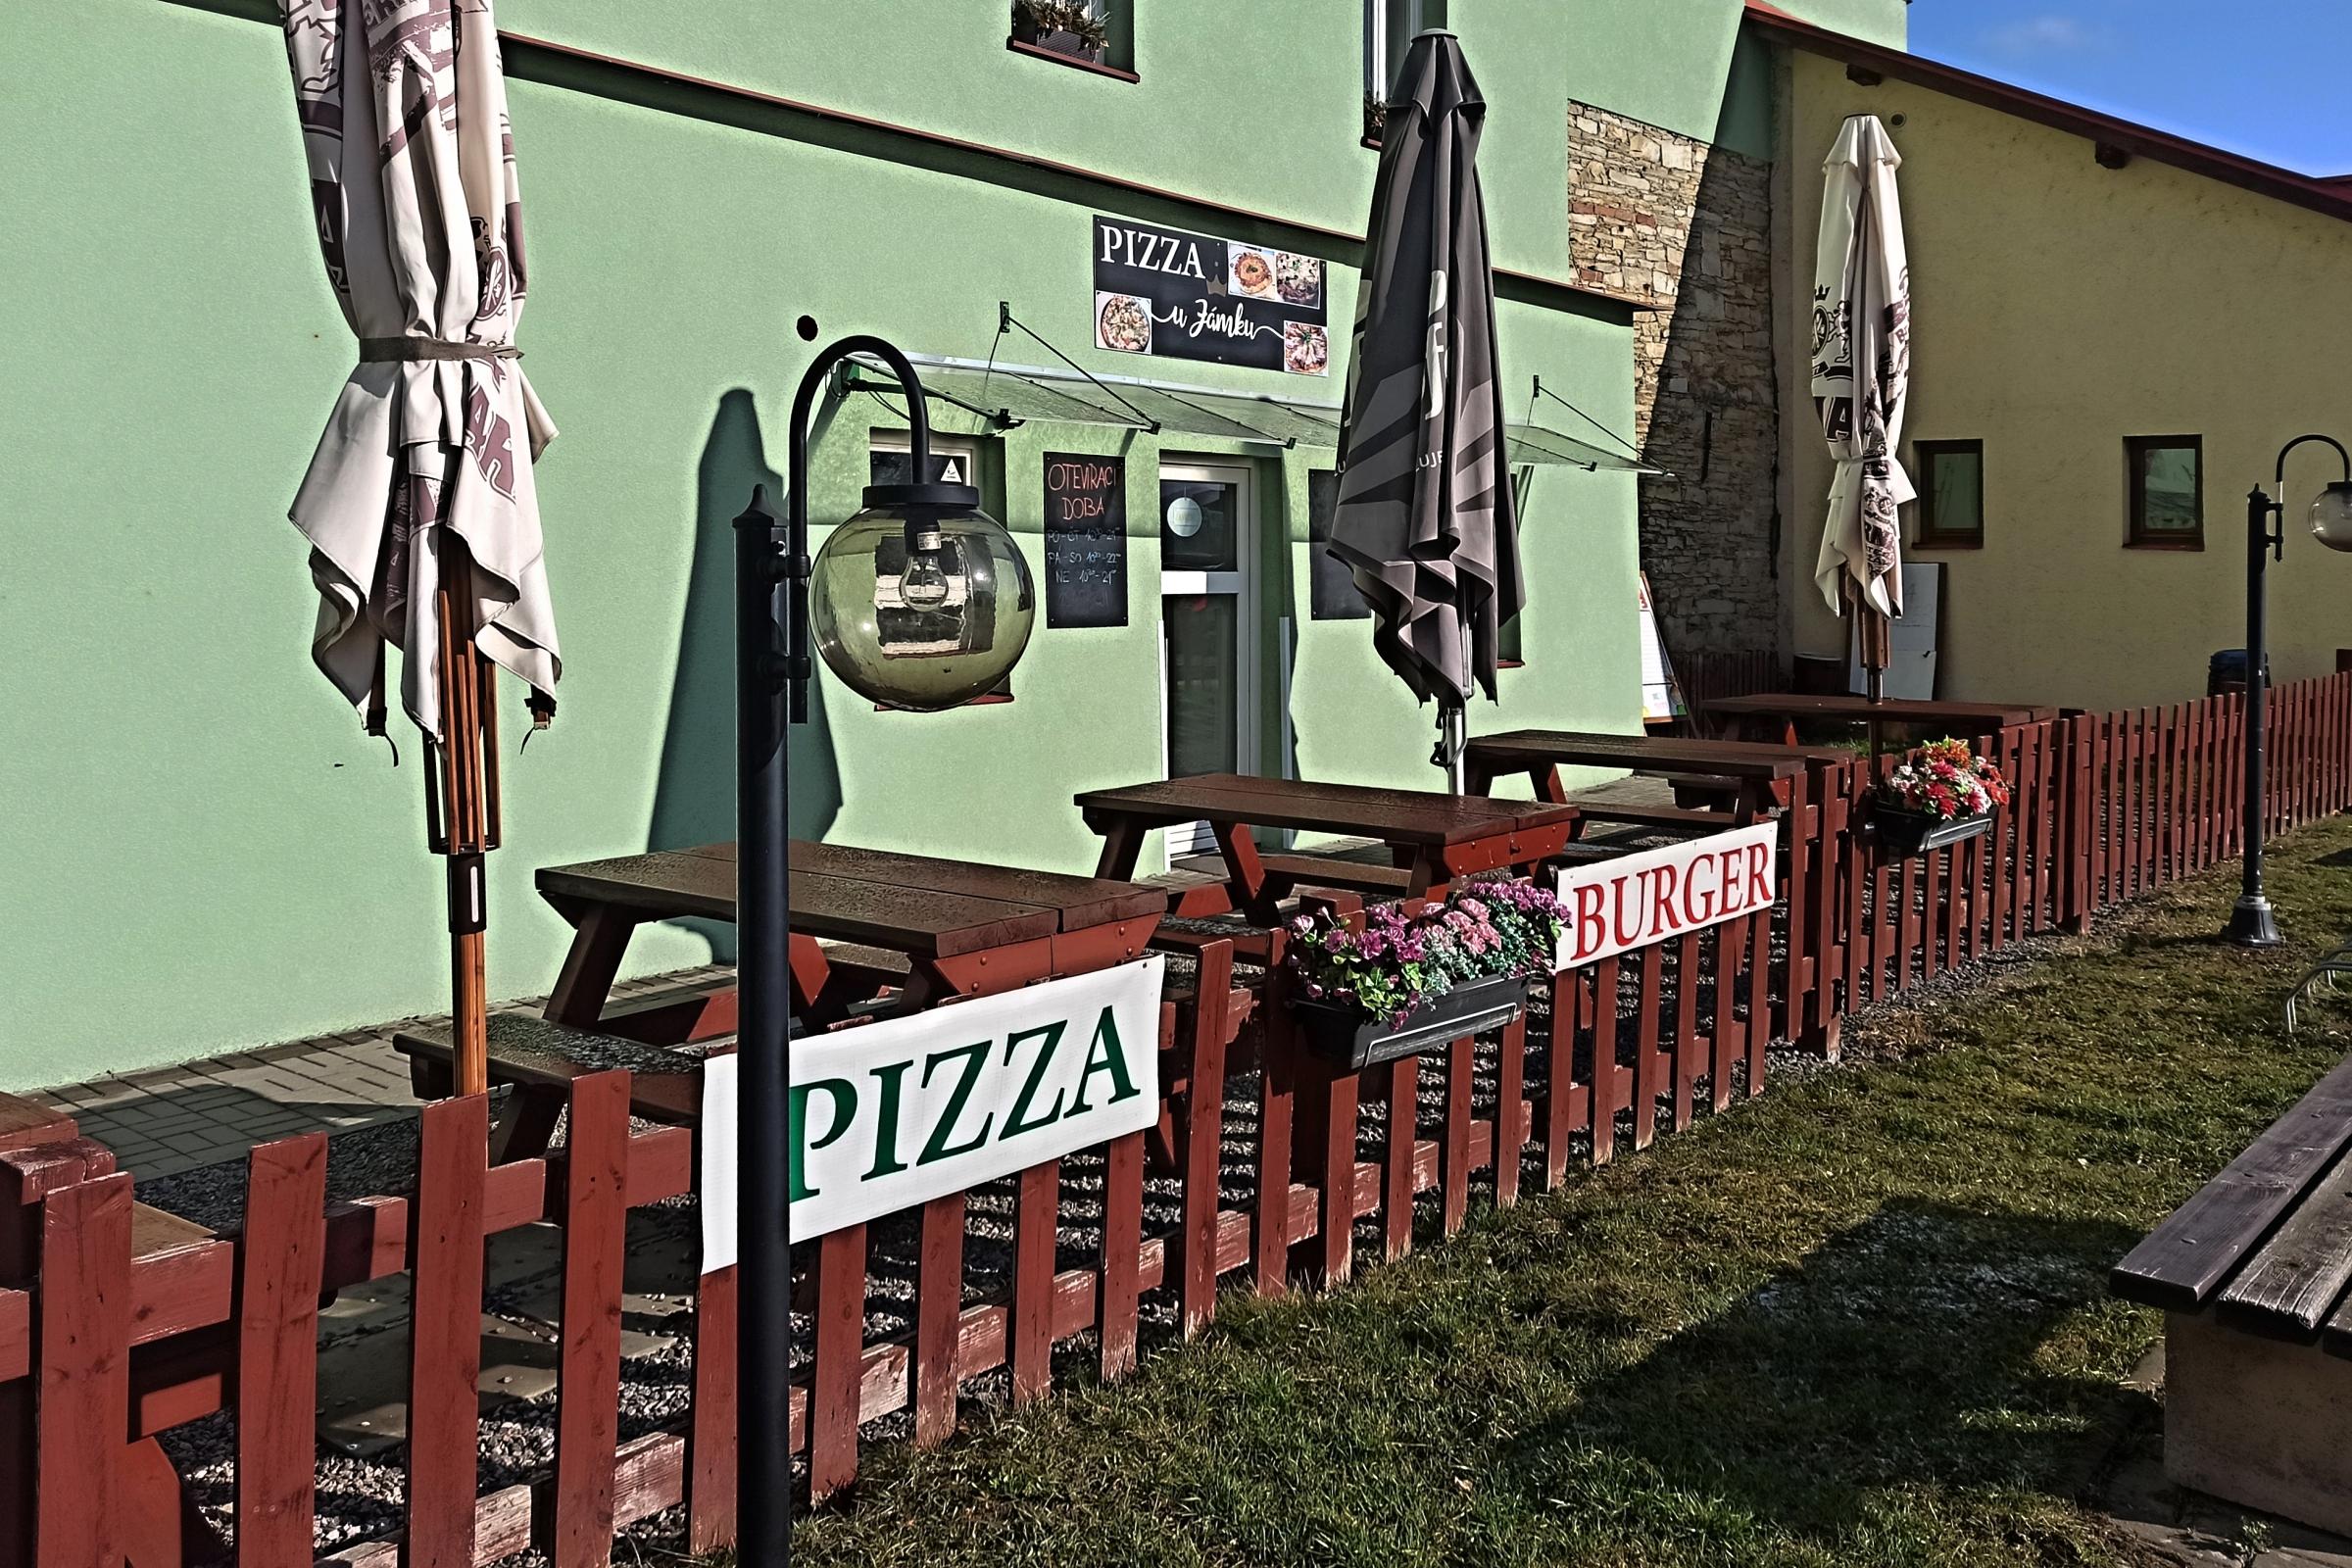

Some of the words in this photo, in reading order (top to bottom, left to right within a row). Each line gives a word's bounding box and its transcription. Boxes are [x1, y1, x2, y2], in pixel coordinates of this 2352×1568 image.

[1100, 224, 1206, 279] PIZZA
[1061, 496, 1105, 520] DOBA
[1055, 570, 1070, 584] NE
[1570, 842, 1774, 961] BURGER
[790, 1004, 1141, 1203] PIZZA
